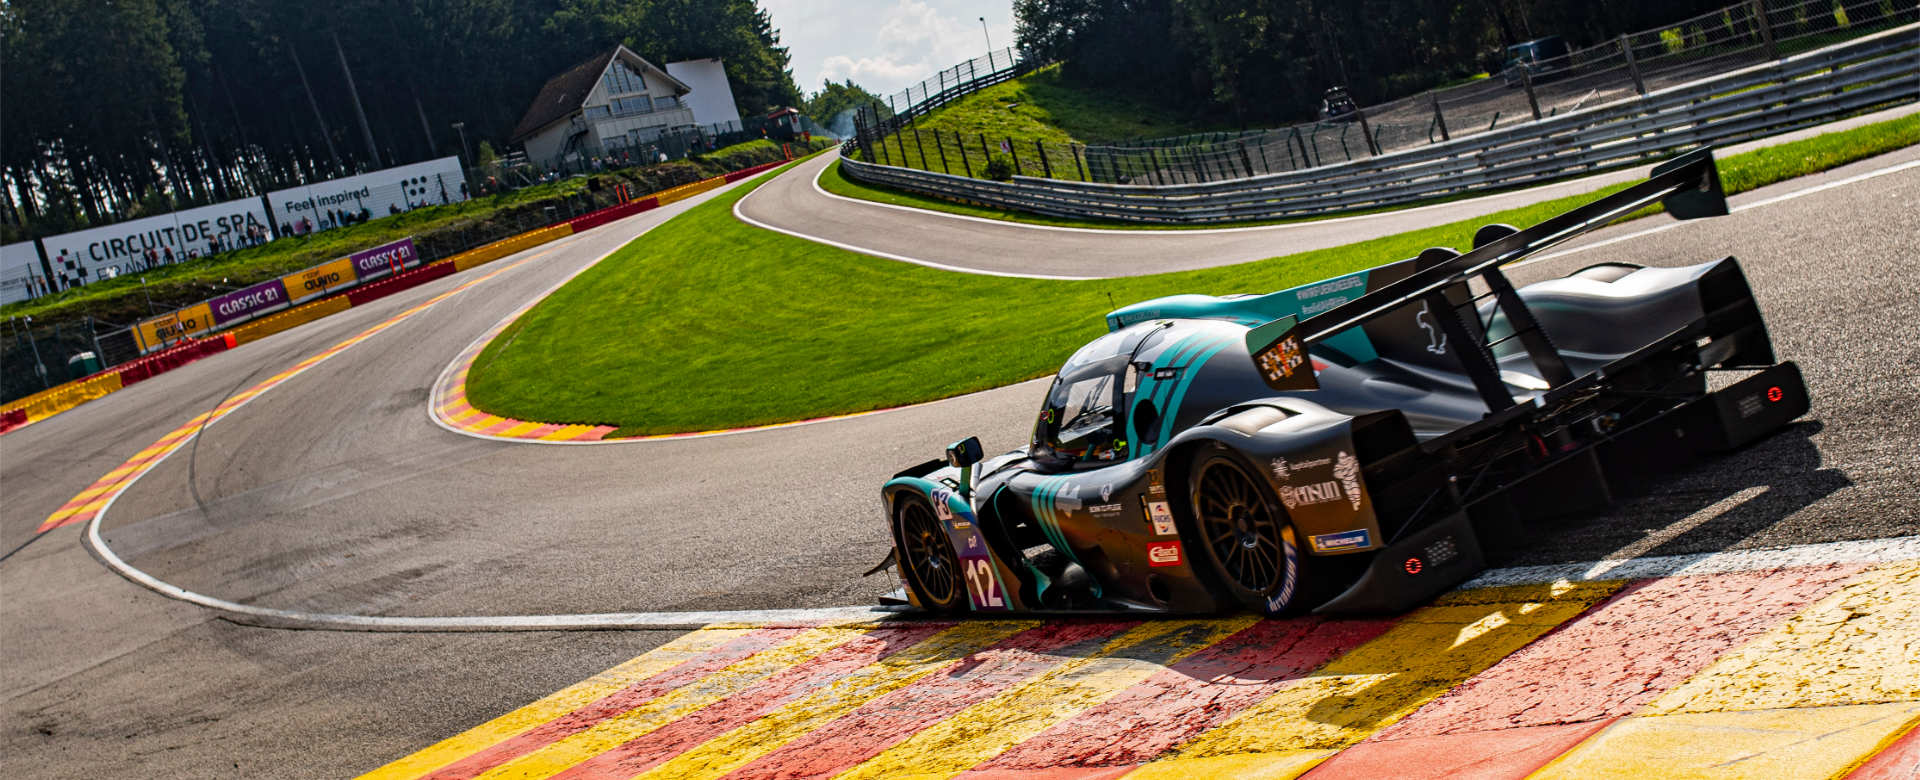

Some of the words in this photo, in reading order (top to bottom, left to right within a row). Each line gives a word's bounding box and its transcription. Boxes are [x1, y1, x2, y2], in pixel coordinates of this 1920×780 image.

[285, 198, 315, 213] Feel
[317, 186, 370, 207] inspired
[89, 227, 174, 262] CIRCUIT
[182, 220, 211, 242] DE
[217, 211, 261, 236] SPA
[219, 291, 265, 315] CLASSIC
[265, 287, 279, 301] 21
[967, 559, 1004, 607] 12
